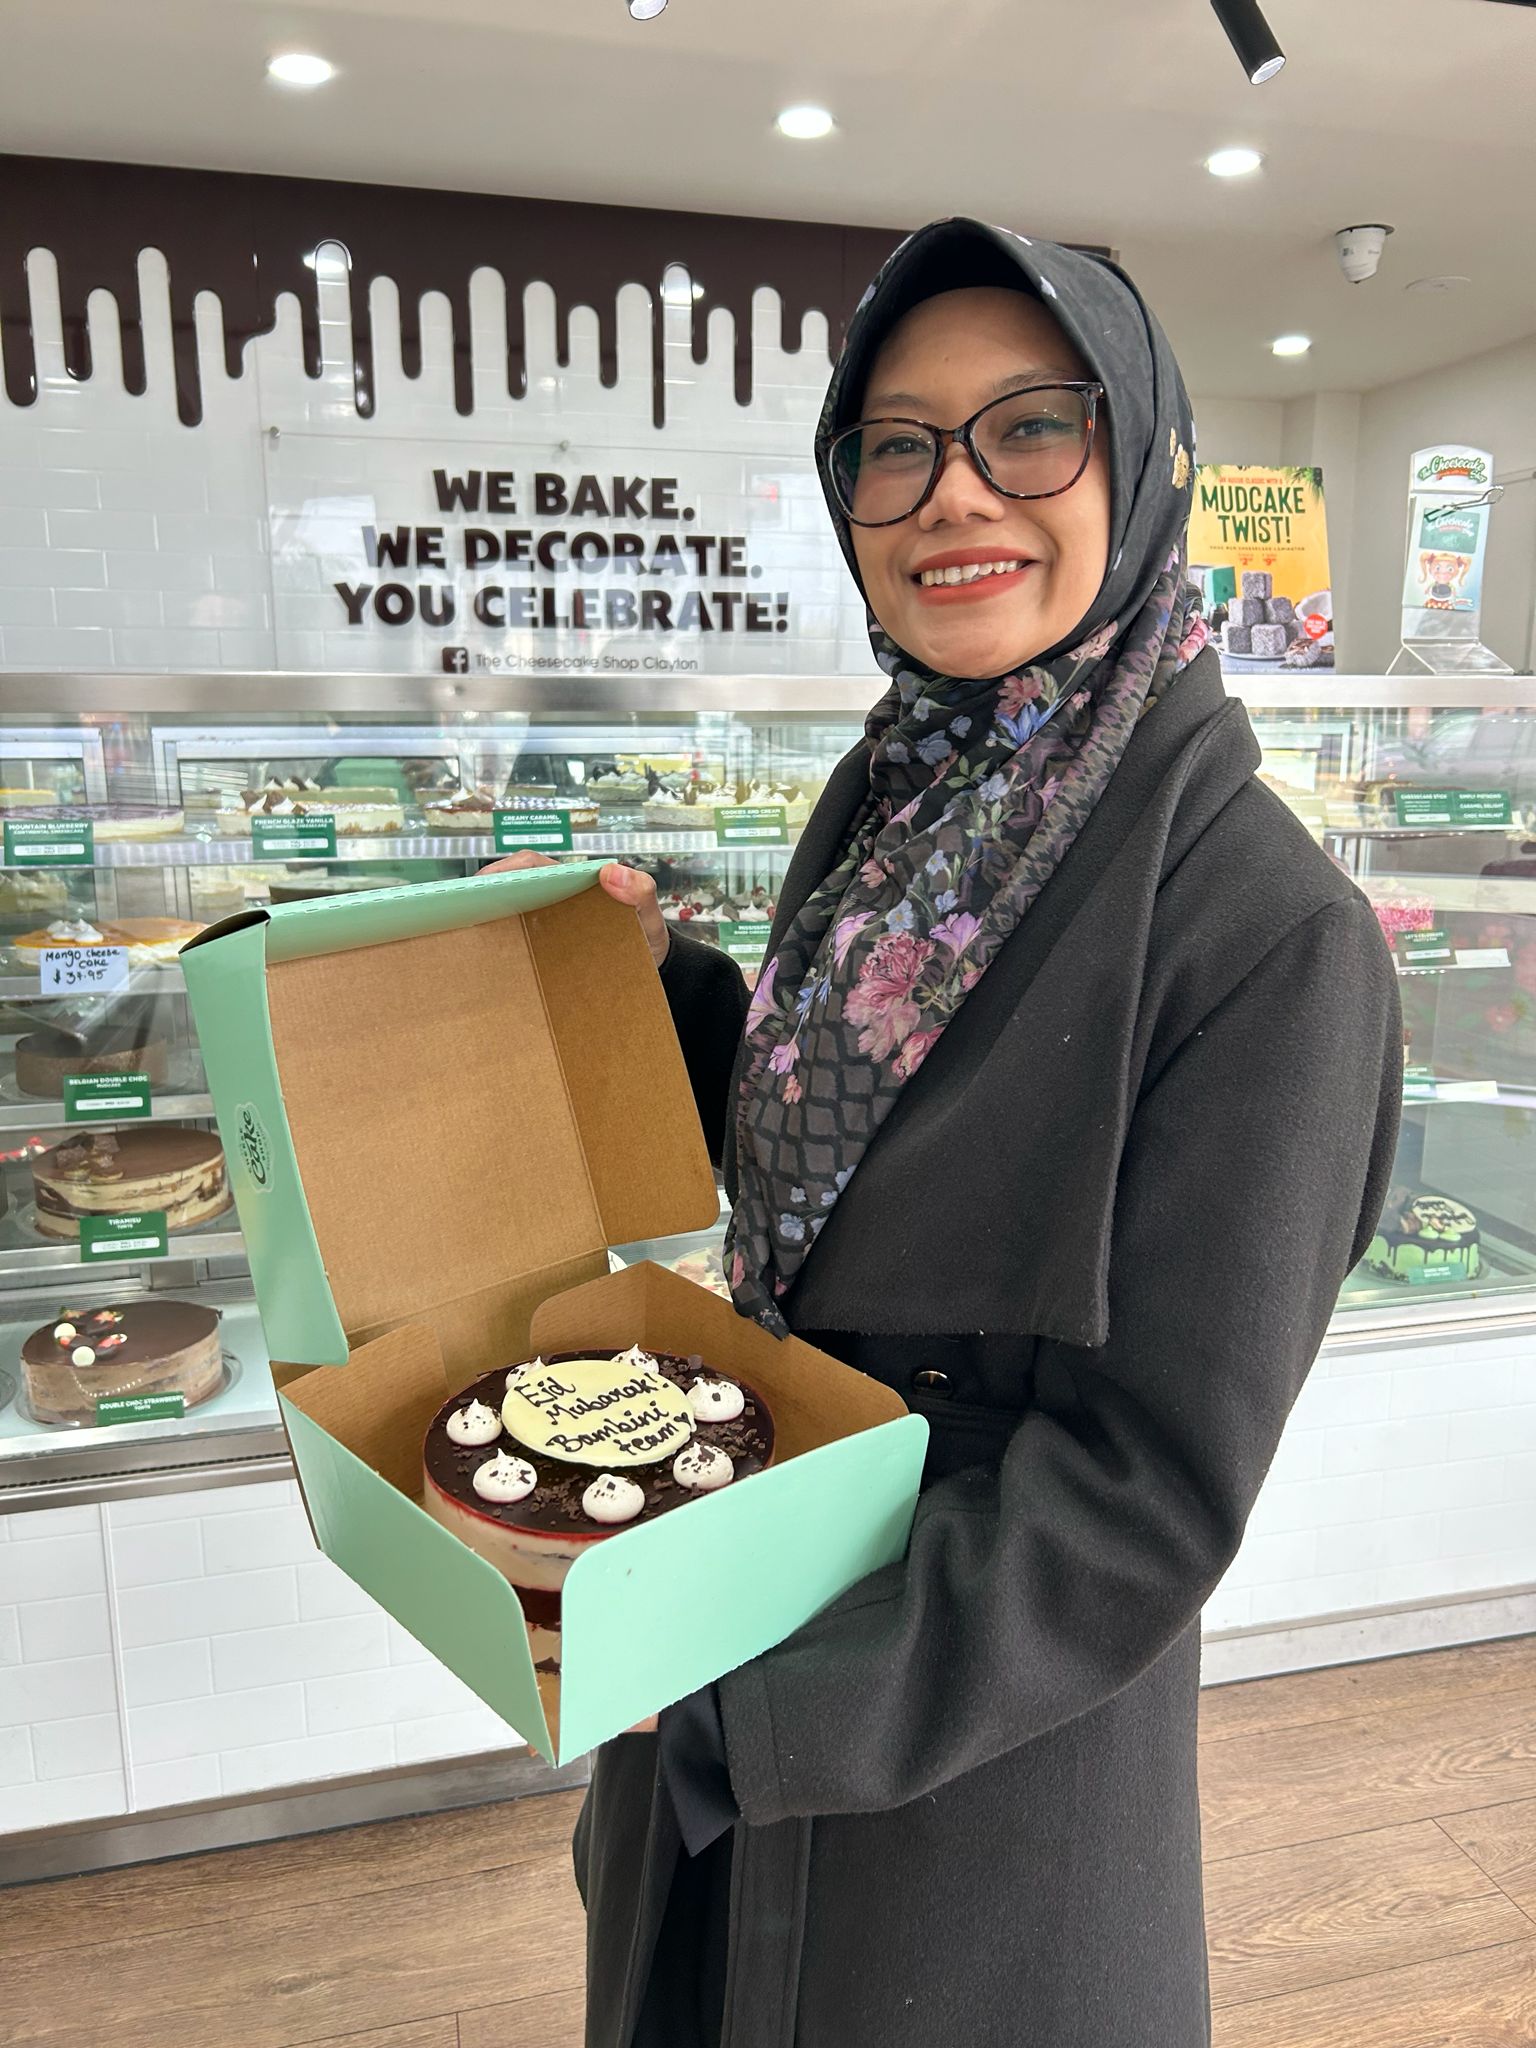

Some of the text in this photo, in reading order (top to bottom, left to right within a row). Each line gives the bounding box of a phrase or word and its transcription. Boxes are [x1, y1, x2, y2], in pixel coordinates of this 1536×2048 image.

[1431, 456, 1485, 474] Cheesecake
[433, 469, 696, 521] WE BAKE.
[1201, 484, 1306, 513] MUDCAKE
[1217, 515, 1290, 543] TWIST!
[361, 525, 762, 579] WE DECORATE.
[334, 582, 789, 633] YOU CELEBRATE!
[476, 654, 501, 667] The
[505, 654, 599, 669] Cheesecake
[602, 656, 640, 671] Shop
[643, 656, 698, 672] Clayton
[46, 950, 81, 968] Mango
[78, 959, 109, 969] cake
[69, 1078, 99, 1086] BELGIAN
[99, 1076, 127, 1084] DOUBLE
[243, 1109, 266, 1185] Cake
[108, 1217, 142, 1226] TIRAMISU
[99, 1395, 184, 1410] DOUBLE CHOC STRAWBERRY
[514, 1376, 576, 1407] Eid
[546, 1372, 670, 1426] Mubarak!
[545, 1400, 669, 1453] Bambini
[613, 1423, 680, 1456] team
